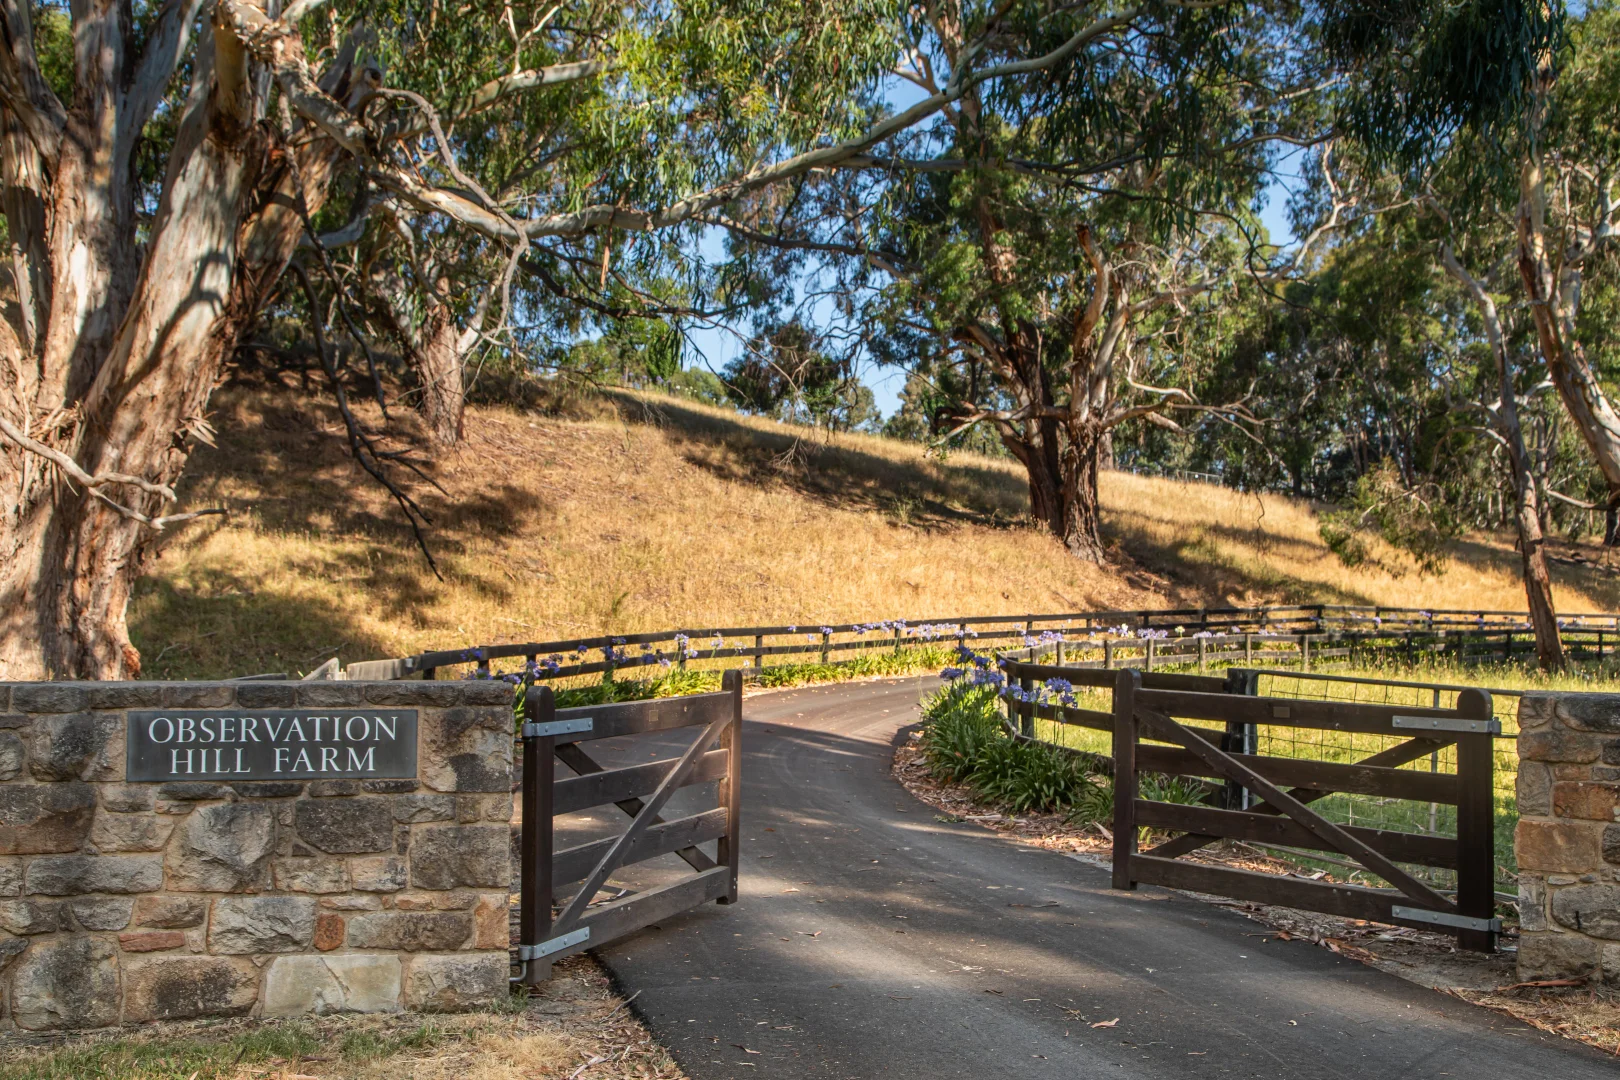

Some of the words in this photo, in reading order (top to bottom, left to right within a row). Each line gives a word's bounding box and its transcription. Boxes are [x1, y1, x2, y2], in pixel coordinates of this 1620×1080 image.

[148, 716, 398, 743] OBSERVATION
[169, 748, 251, 774] HILL
[273, 746, 376, 773] FARM
